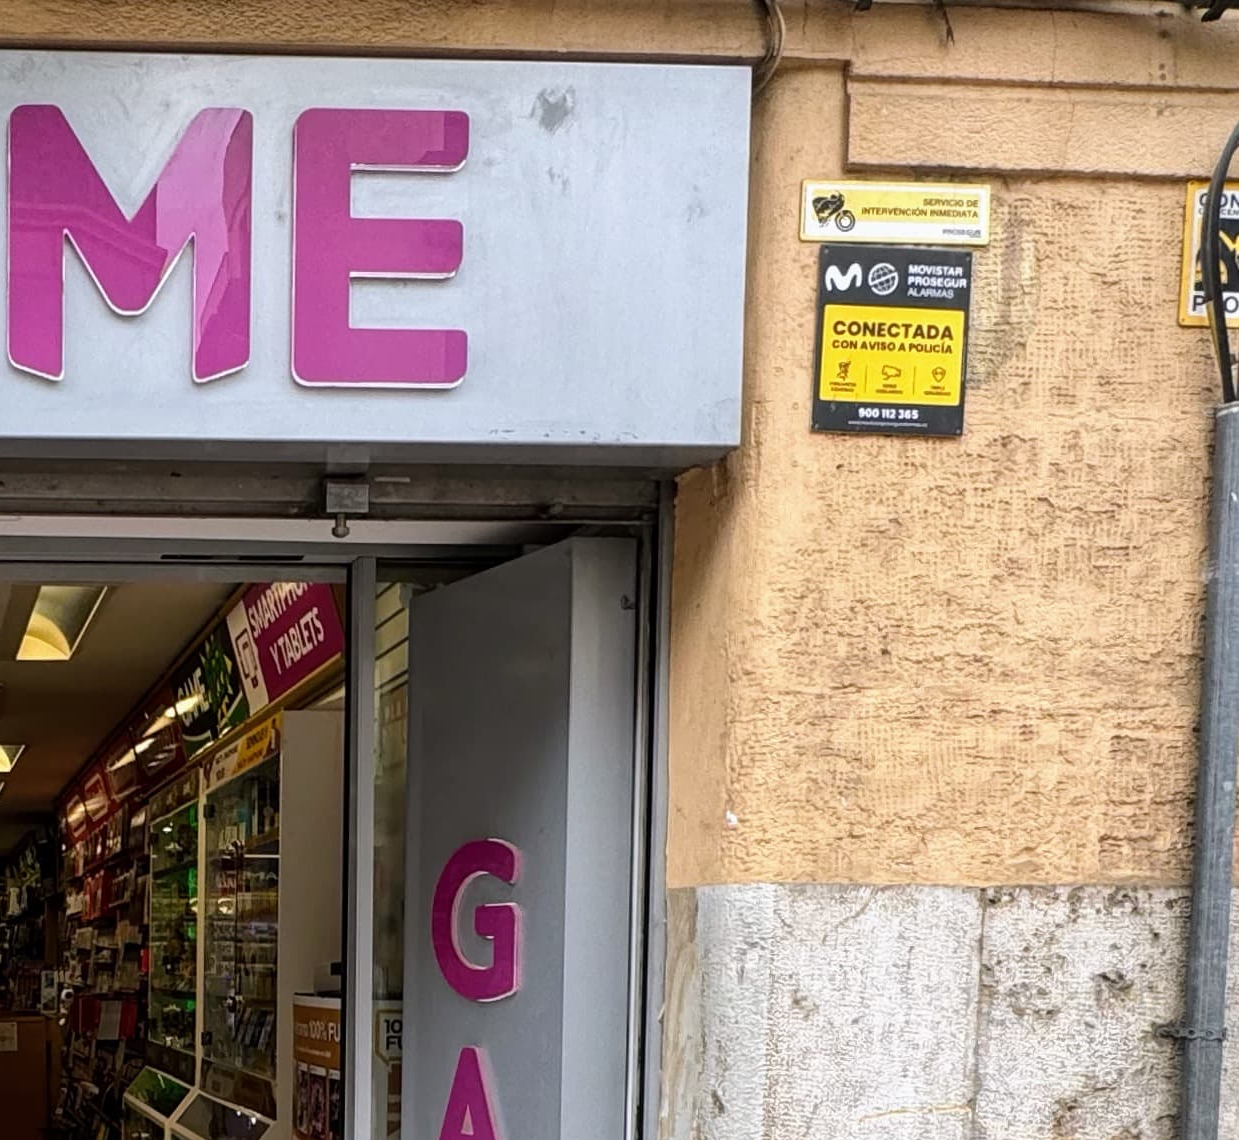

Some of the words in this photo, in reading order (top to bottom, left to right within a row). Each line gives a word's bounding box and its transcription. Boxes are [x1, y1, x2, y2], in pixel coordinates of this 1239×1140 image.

[923, 198, 964, 208] SERVICIO
[966, 199, 979, 208] DE
[861, 206, 927, 217] INTERVENCIÓN
[929, 209, 979, 218] INMEDIATA
[908, 264, 963, 277] MOVISTAR
[907, 276, 967, 289] PROSEGUR
[907, 287, 954, 299] ALARMAS
[833, 320, 954, 340] CONECTADA
[832, 340, 858, 350] CON
[861, 341, 896, 352] AVISO
[898, 342, 907, 352] A
[909, 343, 953, 354] POLICÍA
[858, 407, 880, 419] 900
[882, 408, 896, 420] 112
[269, 641, 282, 676] Y
[277, 606, 325, 670] TABLETS
